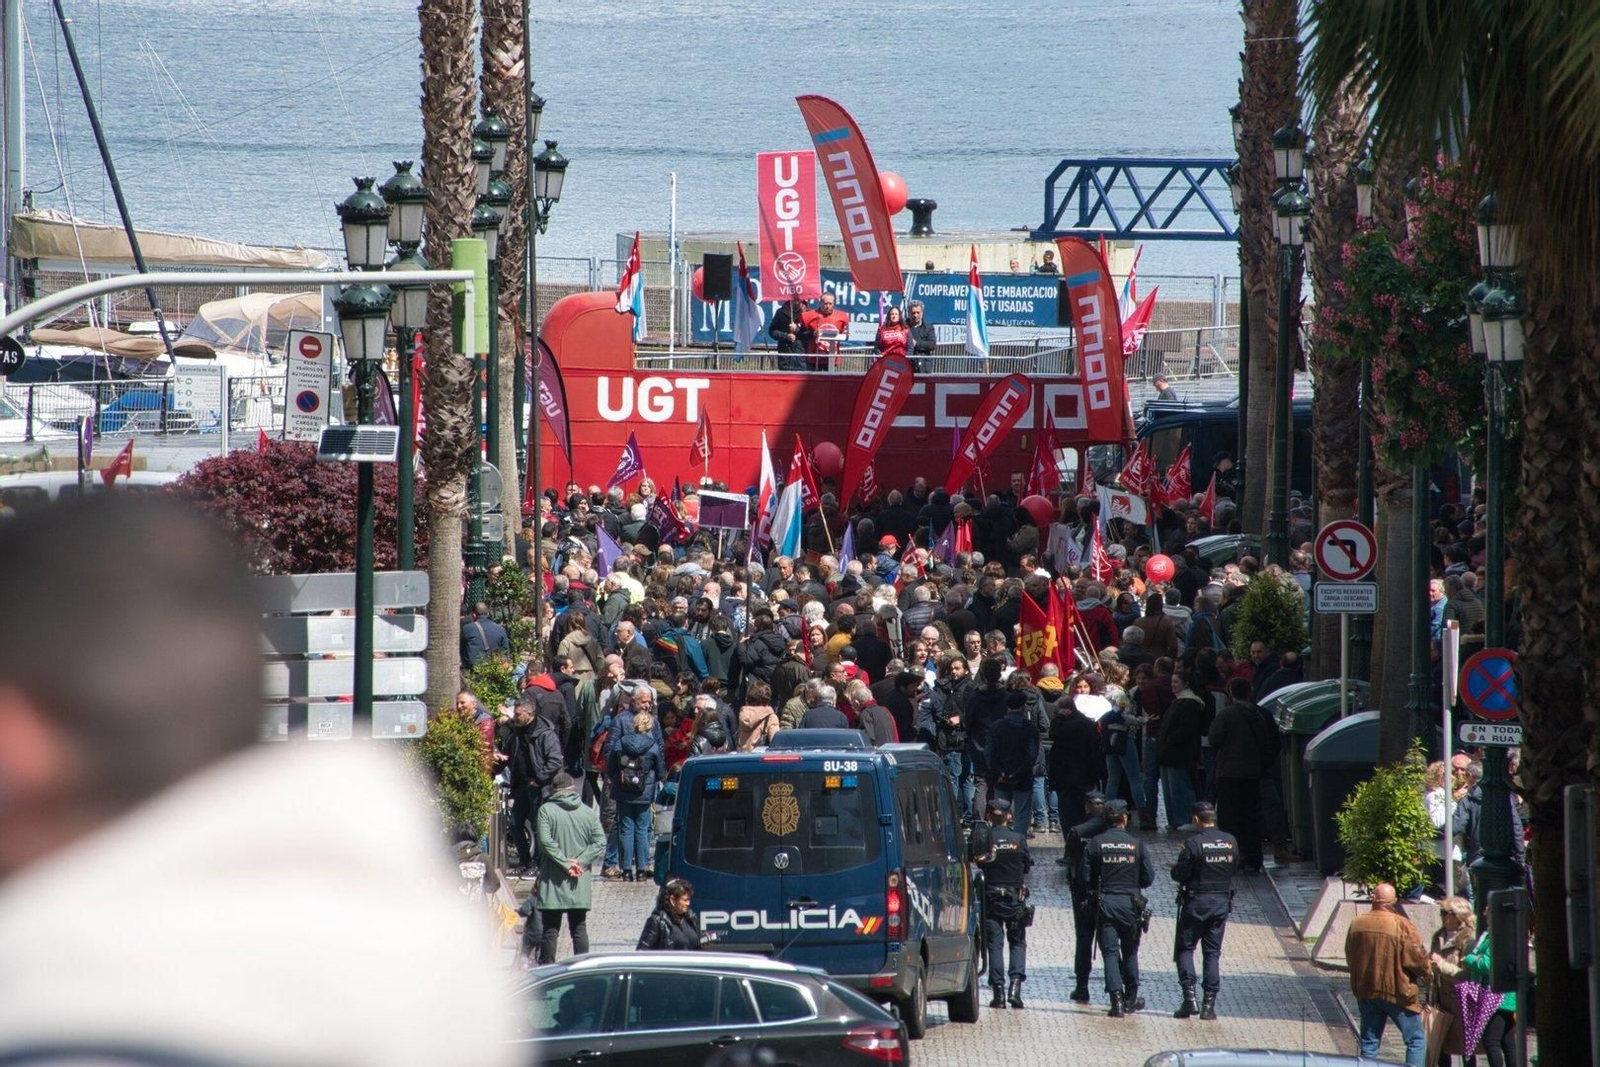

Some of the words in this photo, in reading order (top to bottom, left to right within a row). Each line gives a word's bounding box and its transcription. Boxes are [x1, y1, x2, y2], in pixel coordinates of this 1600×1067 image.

[774, 155, 800, 251] UGT
[780, 284, 803, 296] VIGO
[984, 287, 995, 298] DE
[991, 301, 996, 311] Y
[998, 301, 1035, 313] USADAS
[0, 351, 18, 364] AS
[597, 376, 710, 422] UGT
[855, 369, 900, 449] CCOO
[1492, 726, 1521, 734] TODA
[1492, 734, 1515, 742] RÚA
[824, 761, 858, 772] 8U-38
[700, 904, 864, 931] POLICÍA
